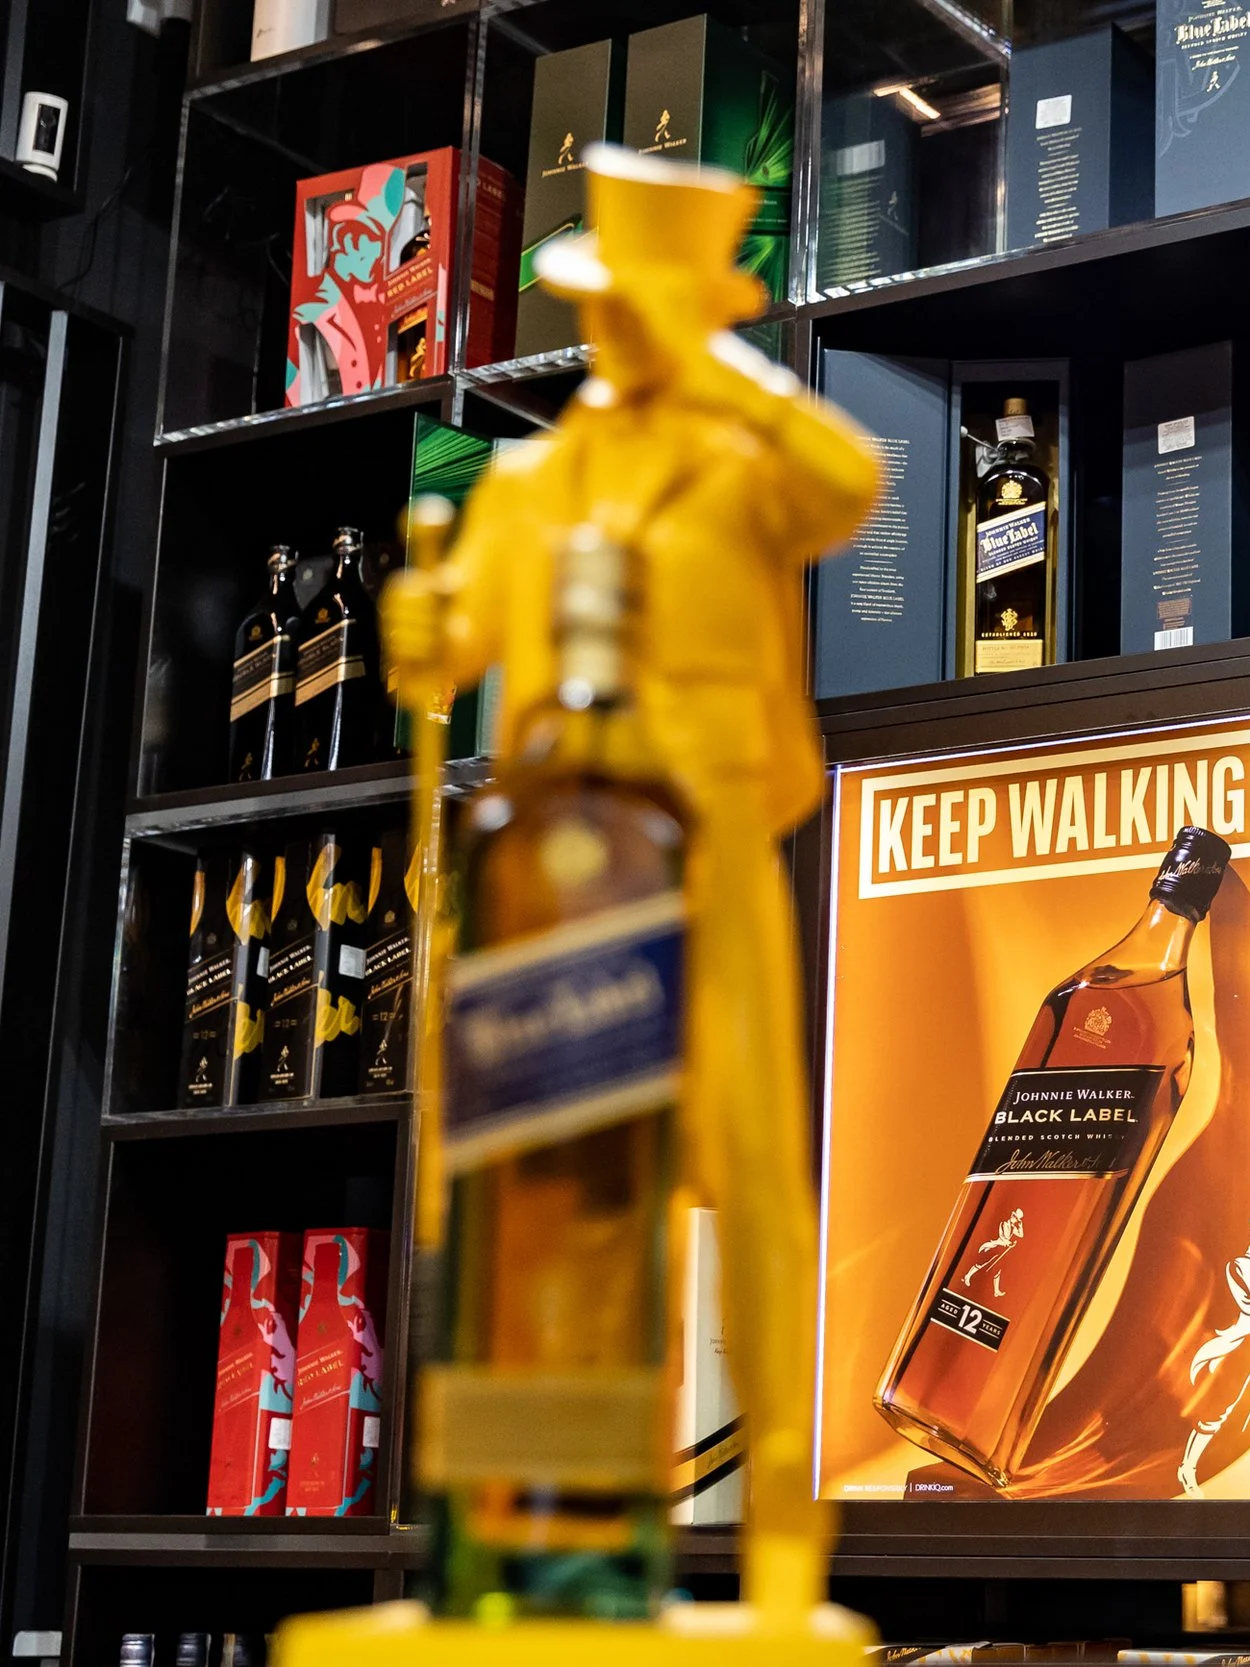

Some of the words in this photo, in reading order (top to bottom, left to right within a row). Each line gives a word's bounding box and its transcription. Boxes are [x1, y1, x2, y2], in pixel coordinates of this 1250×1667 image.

[1174, 24, 1212, 44] Blue
[979, 532, 1009, 555] Blue
[1005, 521, 1039, 546] Label
[878, 786, 997, 874] KEEP
[1008, 755, 1246, 859] WALKING
[1013, 1091, 1073, 1105] JOHNNIE
[1077, 1088, 1132, 1100] WALKER
[994, 1108, 1064, 1125] BLACK
[1070, 1108, 1136, 1123] LABEL
[988, 1134, 1034, 1143] BLENDED
[1040, 1133, 1080, 1141] SCOTCH
[995, 1149, 1034, 1175] John
[1033, 1150, 1082, 1169] Walker
[940, 1302, 958, 1315] AGED
[958, 1304, 982, 1335] 12
[982, 1322, 1001, 1336] YEARS
